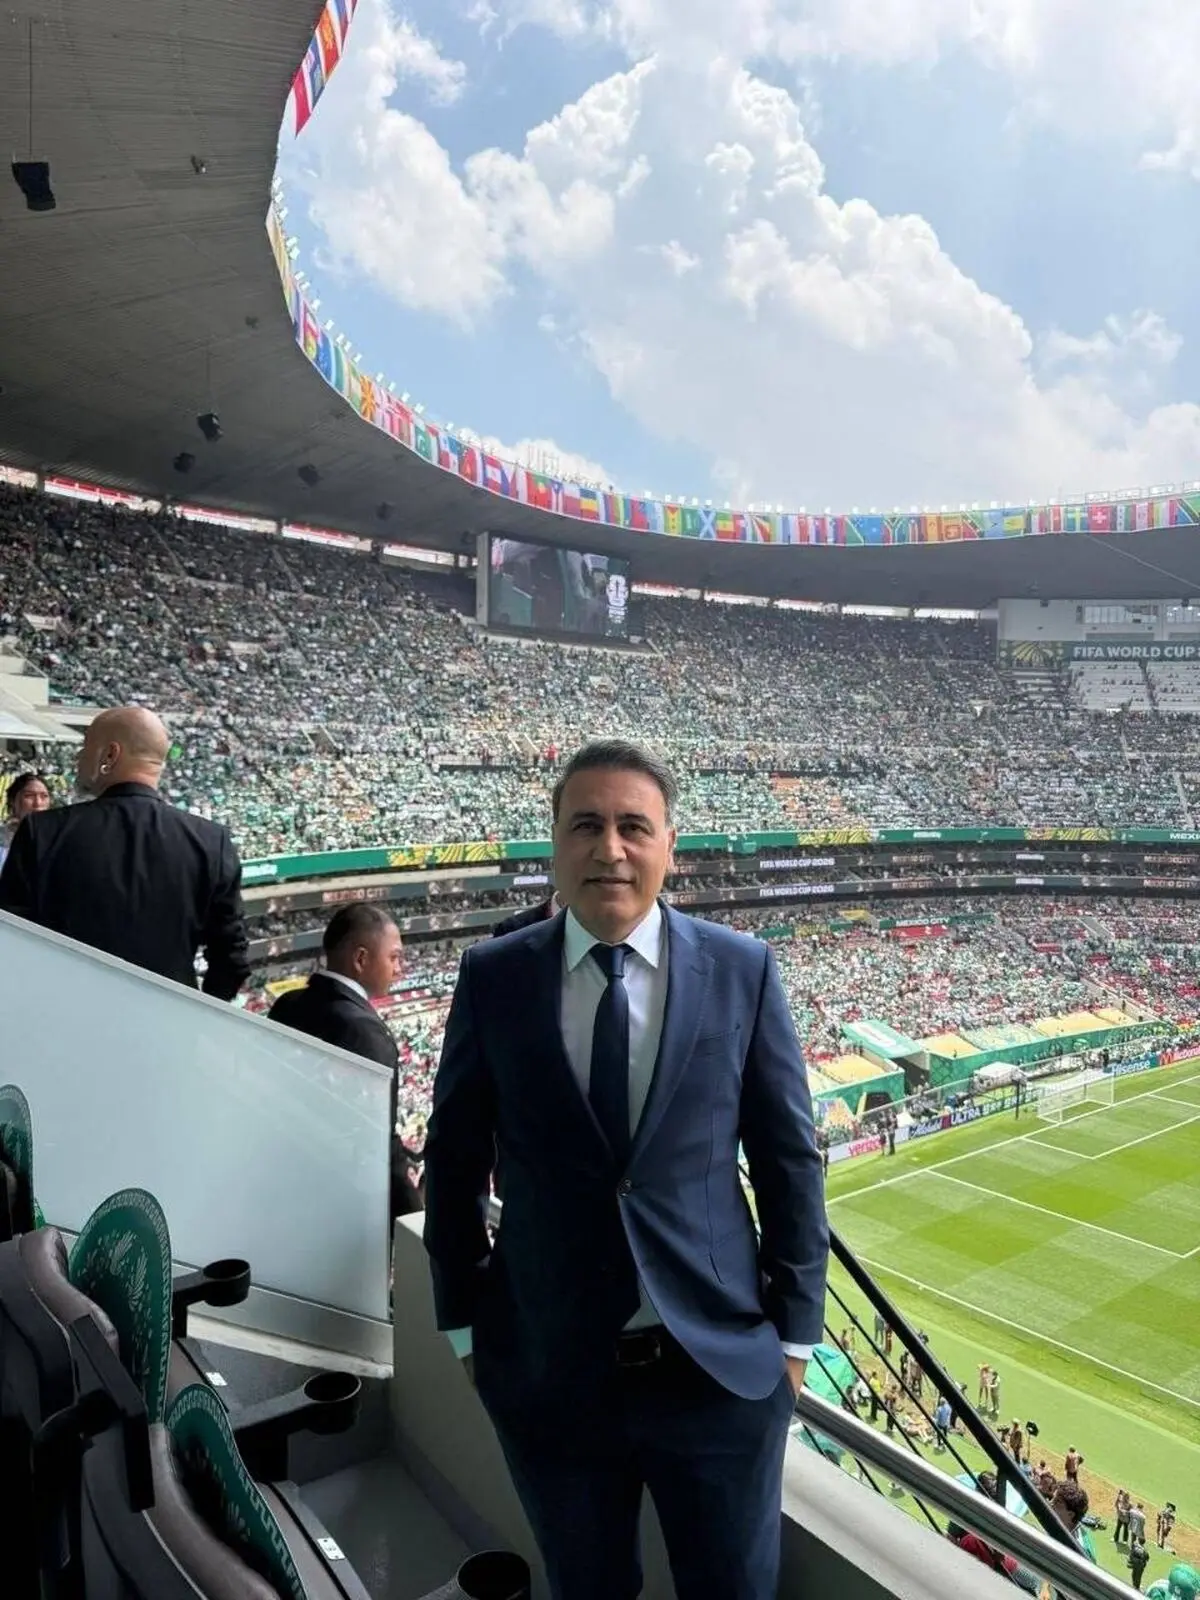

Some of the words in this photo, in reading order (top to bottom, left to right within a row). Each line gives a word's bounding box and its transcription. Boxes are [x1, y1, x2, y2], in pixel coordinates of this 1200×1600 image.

[1074, 646, 1105, 658] FIFA
[1107, 646, 1161, 658] WORLD
[1164, 646, 1196, 658] CUP
[759, 860, 775, 869] FIFA
[775, 859, 798, 868] WORLD
[798, 858, 812, 867] CUP
[759, 888, 774, 897] FIFA
[774, 886, 798, 896] WORLD
[798, 885, 811, 894] CUP
[1111, 1060, 1151, 1073] Hisense
[951, 1106, 981, 1125] ULTRA
